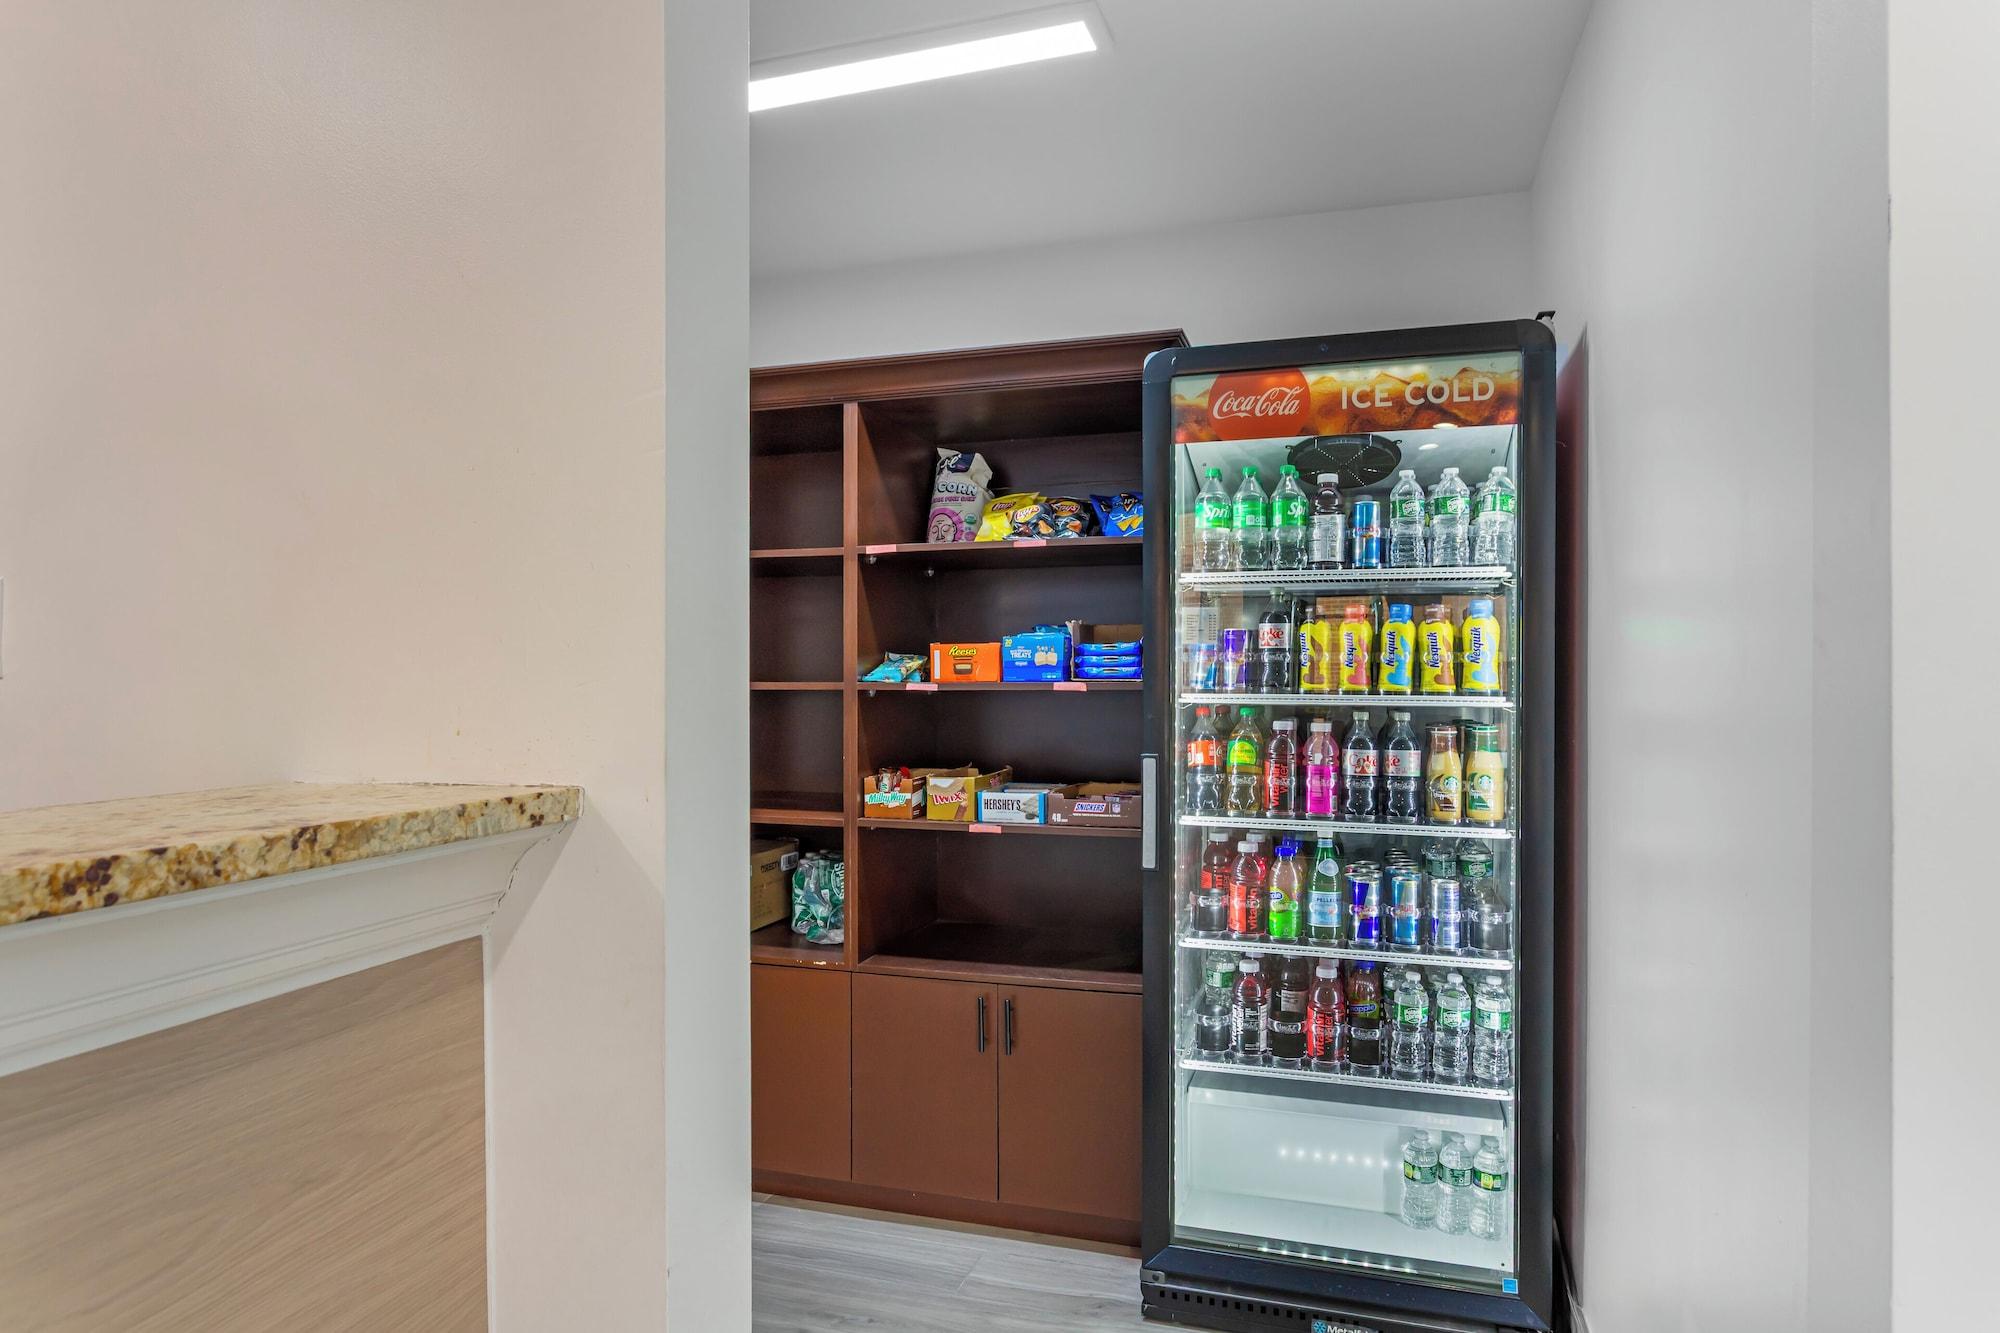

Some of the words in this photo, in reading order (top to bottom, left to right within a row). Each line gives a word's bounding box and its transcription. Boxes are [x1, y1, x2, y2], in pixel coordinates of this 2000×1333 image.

[1212, 385, 1305, 419] Coca-Cola
[1341, 383, 1393, 410] ICE
[1404, 377, 1495, 406] COLD
[937, 481, 978, 496] CORN
[1205, 503, 1230, 519] Spri
[1344, 632, 1357, 668] Nesquik
[1385, 631, 1398, 667] Nesquik
[1427, 632, 1441, 668] Nesquik
[1470, 627, 1485, 664] Nesquik
[983, 799, 1021, 811] HERSHEY'S
[1075, 803, 1105, 812] SNICKERS
